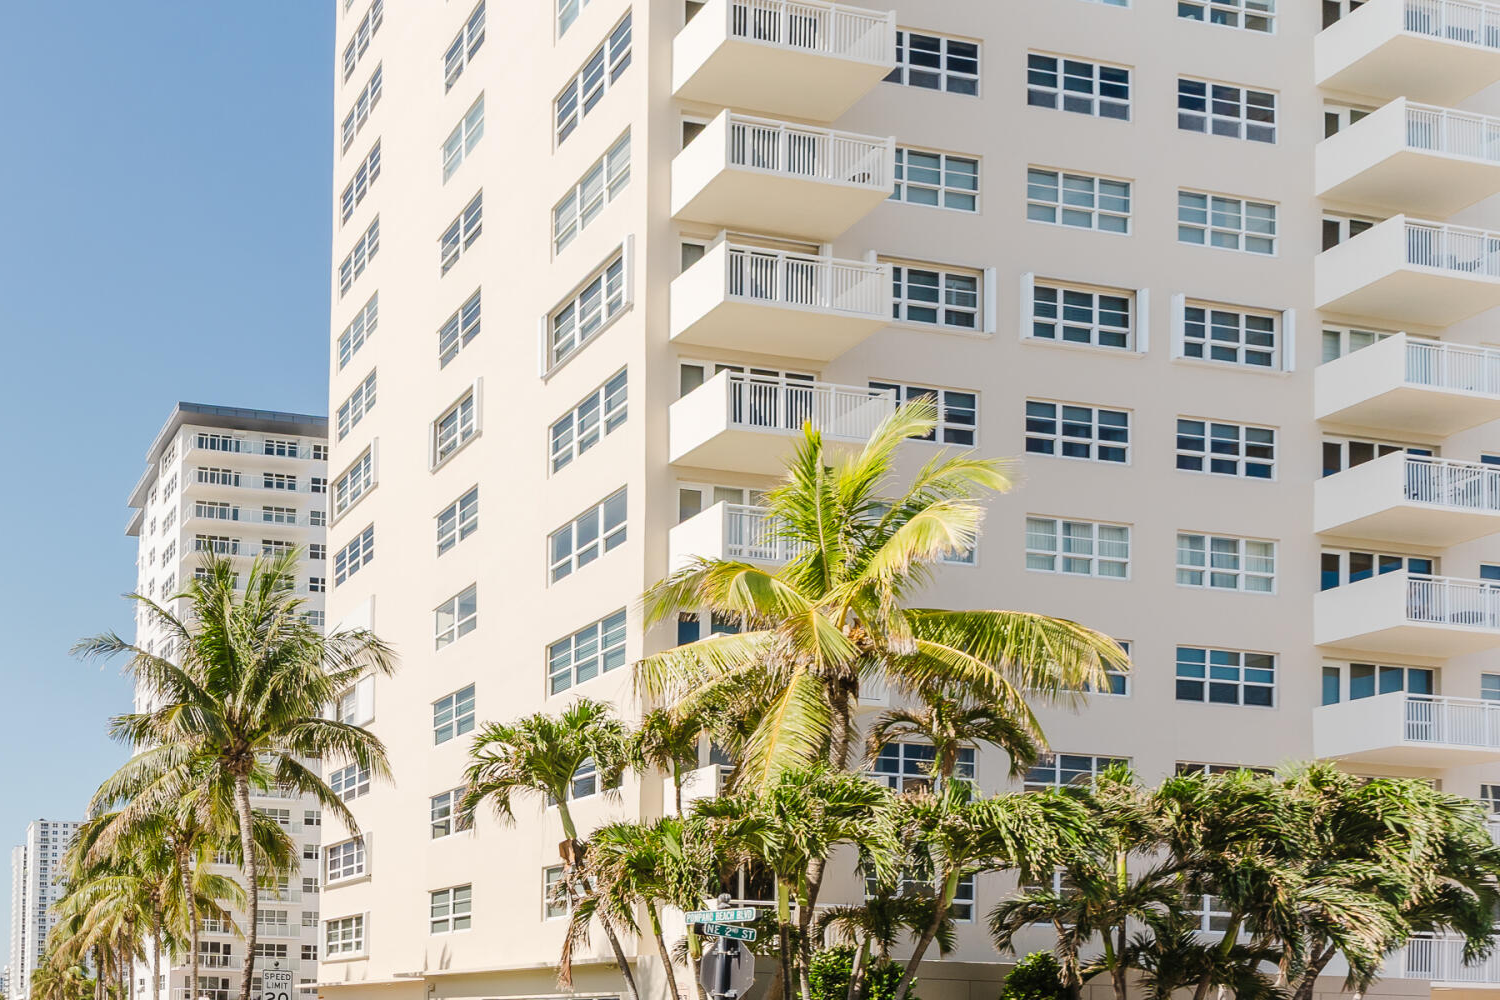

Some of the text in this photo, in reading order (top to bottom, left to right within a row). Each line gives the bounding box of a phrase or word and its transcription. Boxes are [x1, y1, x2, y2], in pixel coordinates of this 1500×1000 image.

[687, 910, 753, 922] POMPANO BEACH BLVD
[707, 924, 720, 934] NE
[741, 930, 754, 940] ST
[264, 973, 291, 981] SPEED
